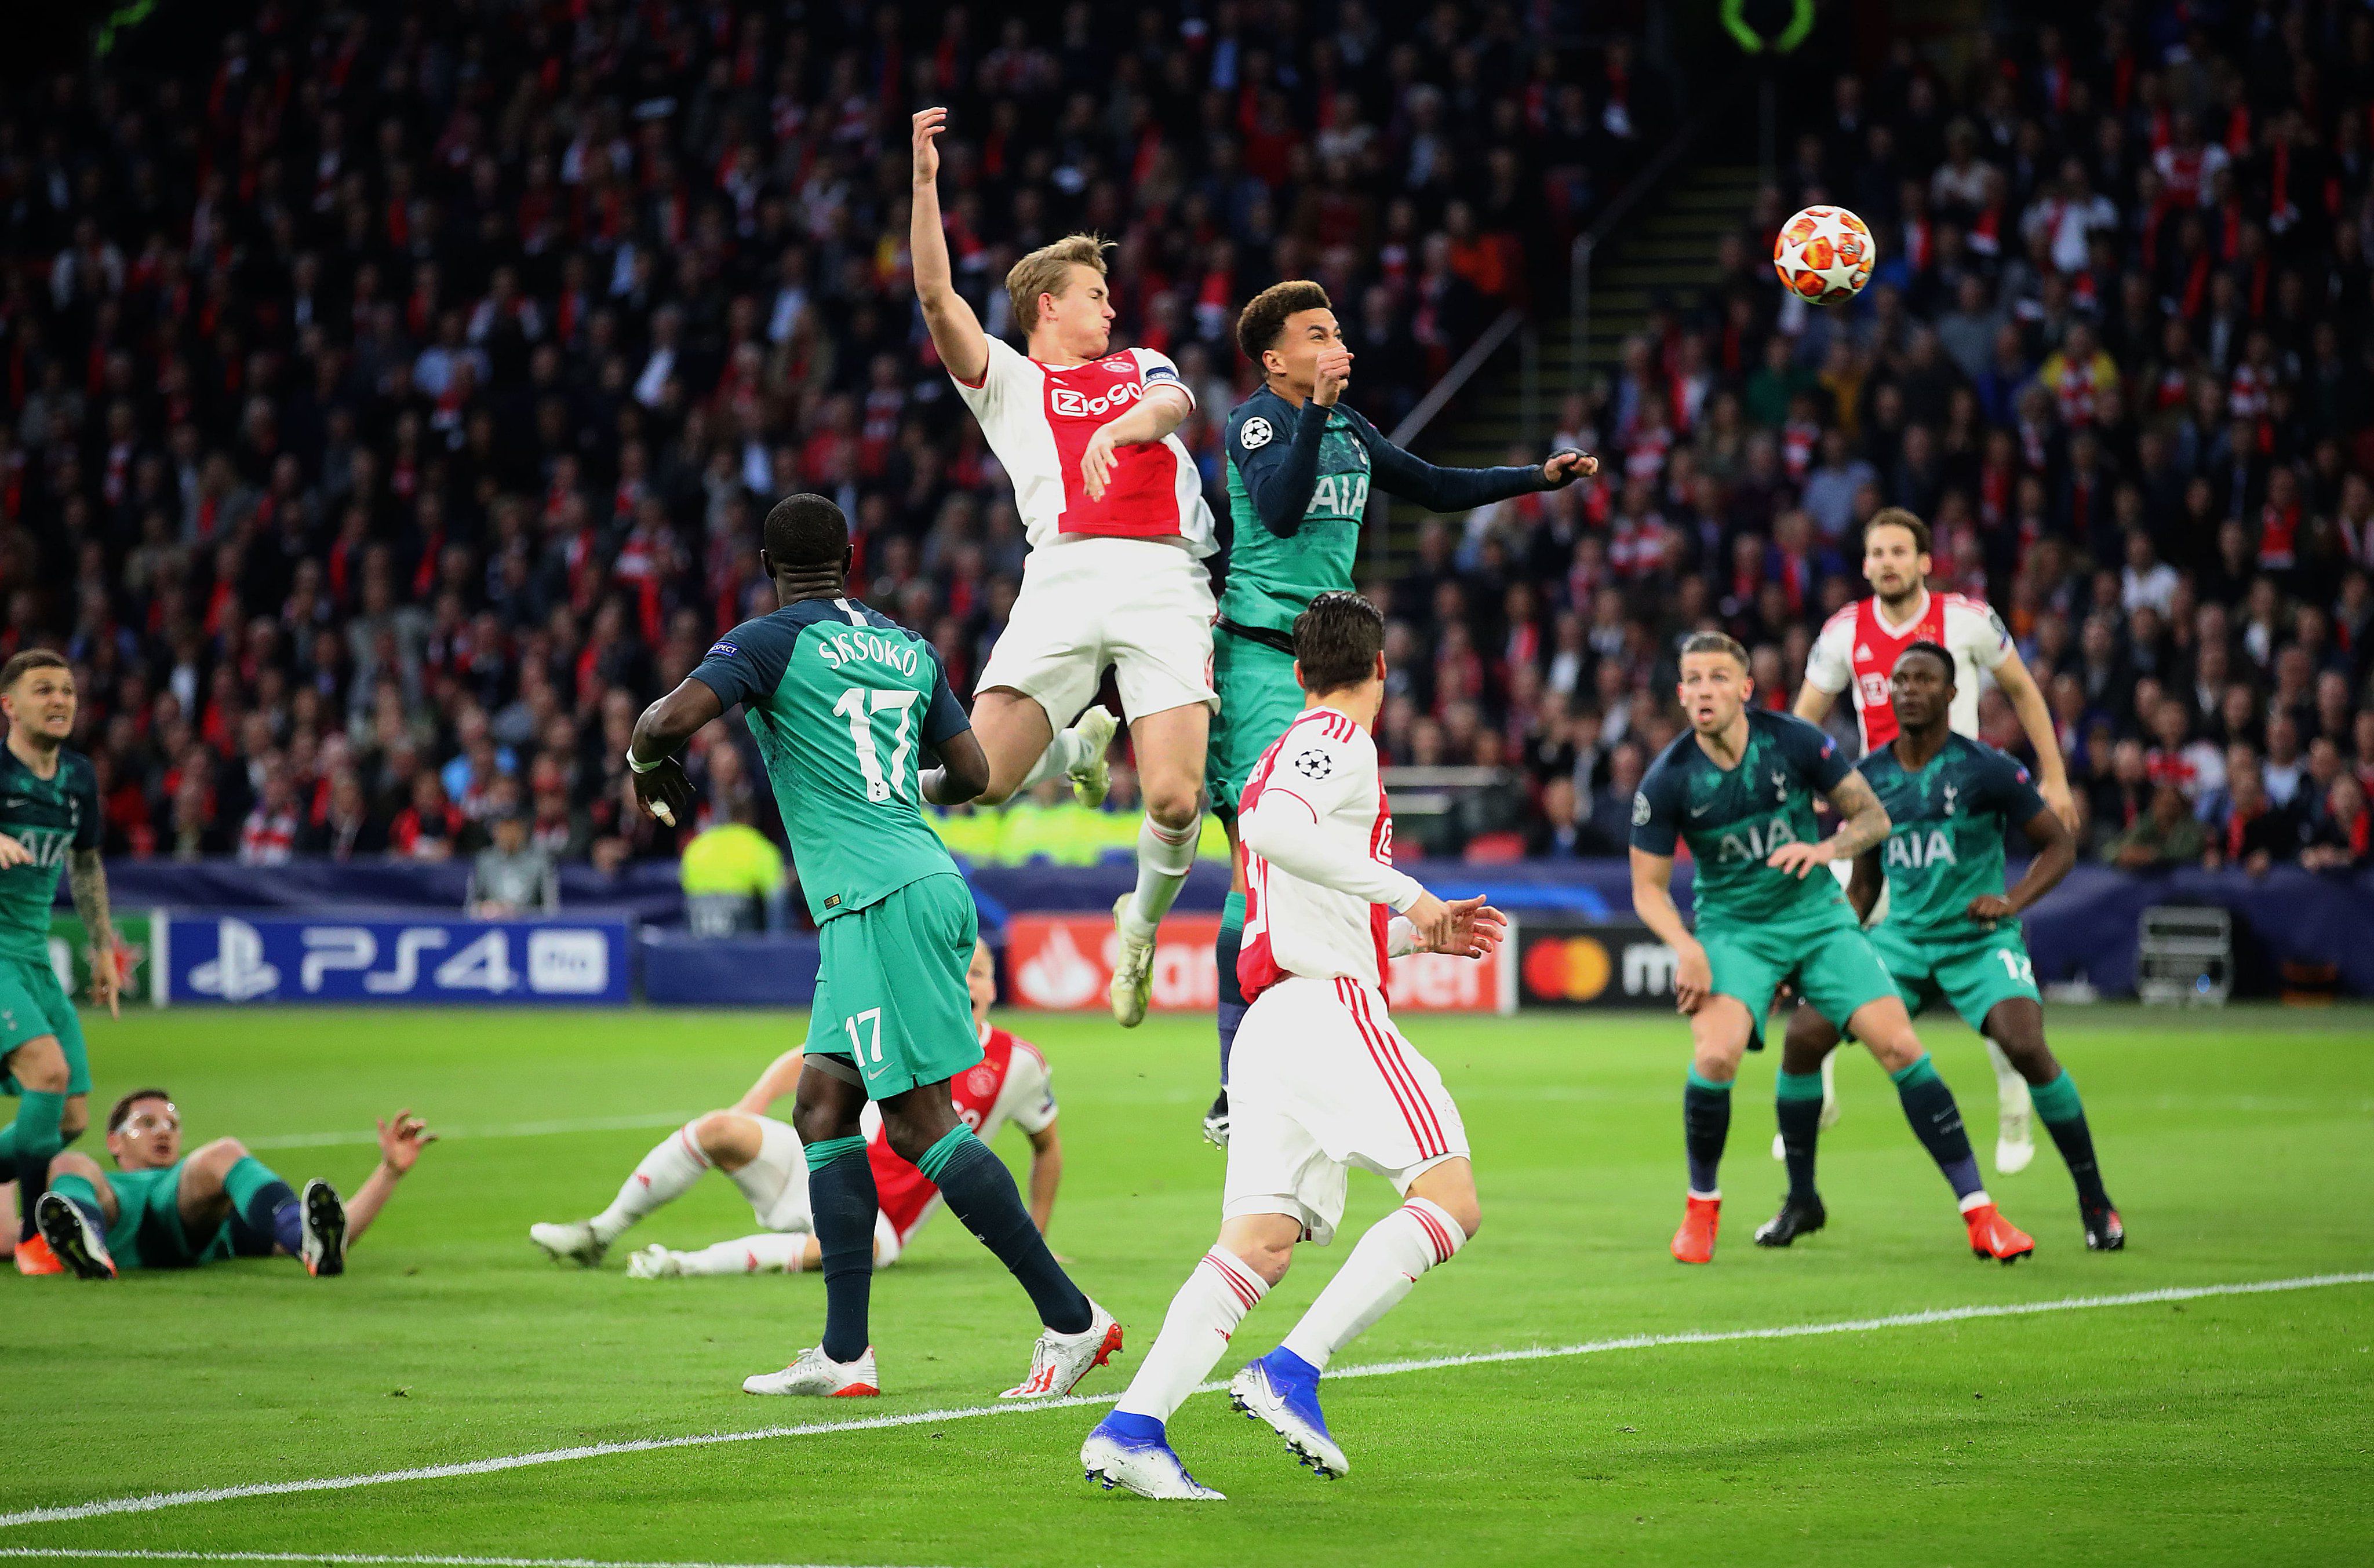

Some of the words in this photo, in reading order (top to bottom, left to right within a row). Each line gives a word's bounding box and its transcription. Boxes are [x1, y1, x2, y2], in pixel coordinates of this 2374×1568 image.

[1305, 476, 1368, 516] AIA
[818, 632, 918, 677] SISSOKO
[832, 688, 920, 802] 17
[1717, 816, 1798, 863] AIA
[1887, 830, 1957, 869] AIA
[301, 927, 518, 994] PS4
[845, 1007, 883, 1068] 17
